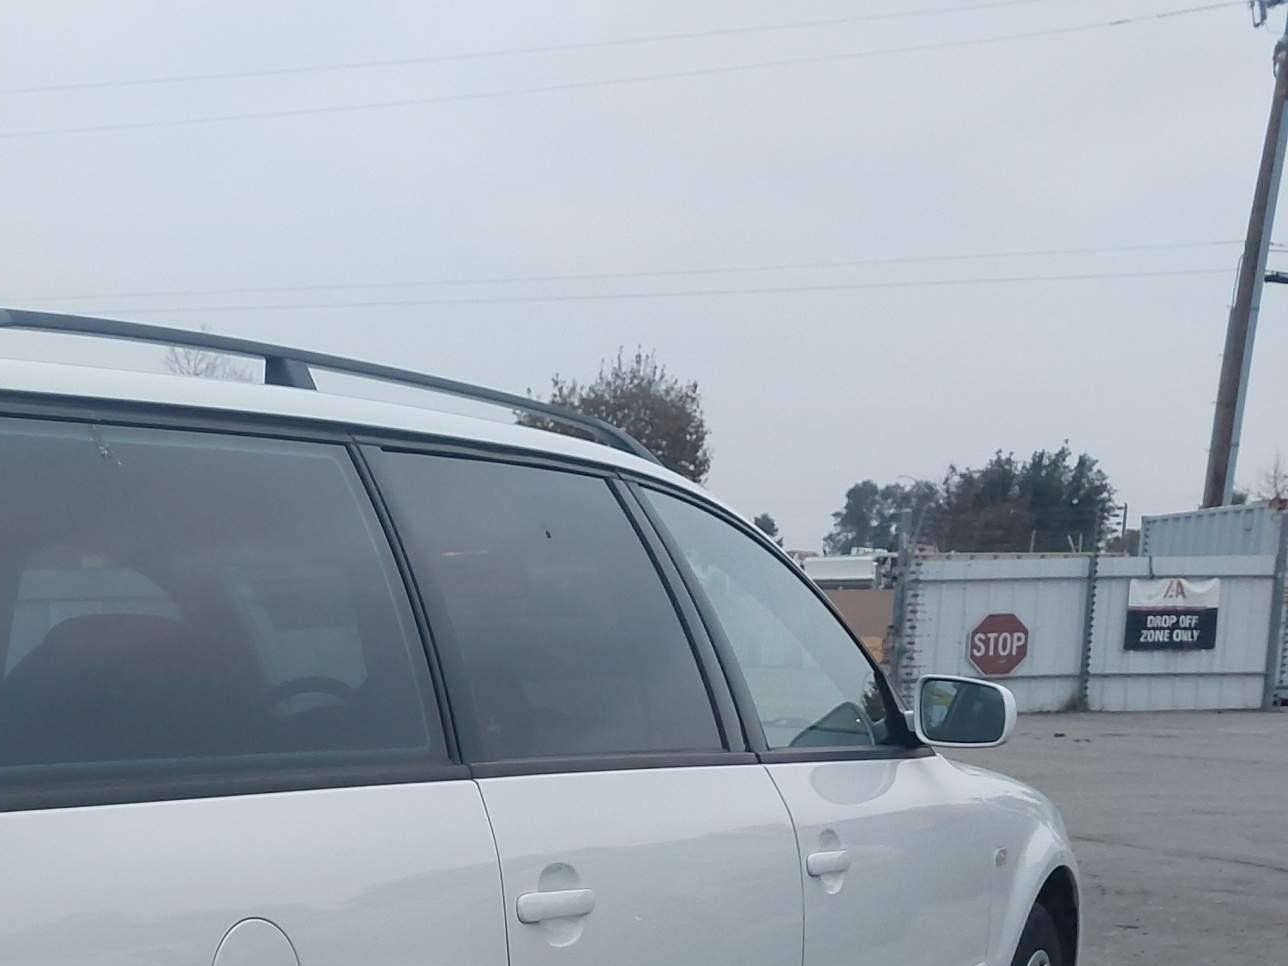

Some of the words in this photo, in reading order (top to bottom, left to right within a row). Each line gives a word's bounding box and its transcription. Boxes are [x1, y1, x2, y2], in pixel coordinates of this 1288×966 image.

[1146, 615, 1177, 628] DROP
[1179, 615, 1200, 628] OFF
[1139, 630, 1170, 642] ZONE
[1172, 629, 1201, 642] ONLY
[973, 631, 1027, 656] STOP
